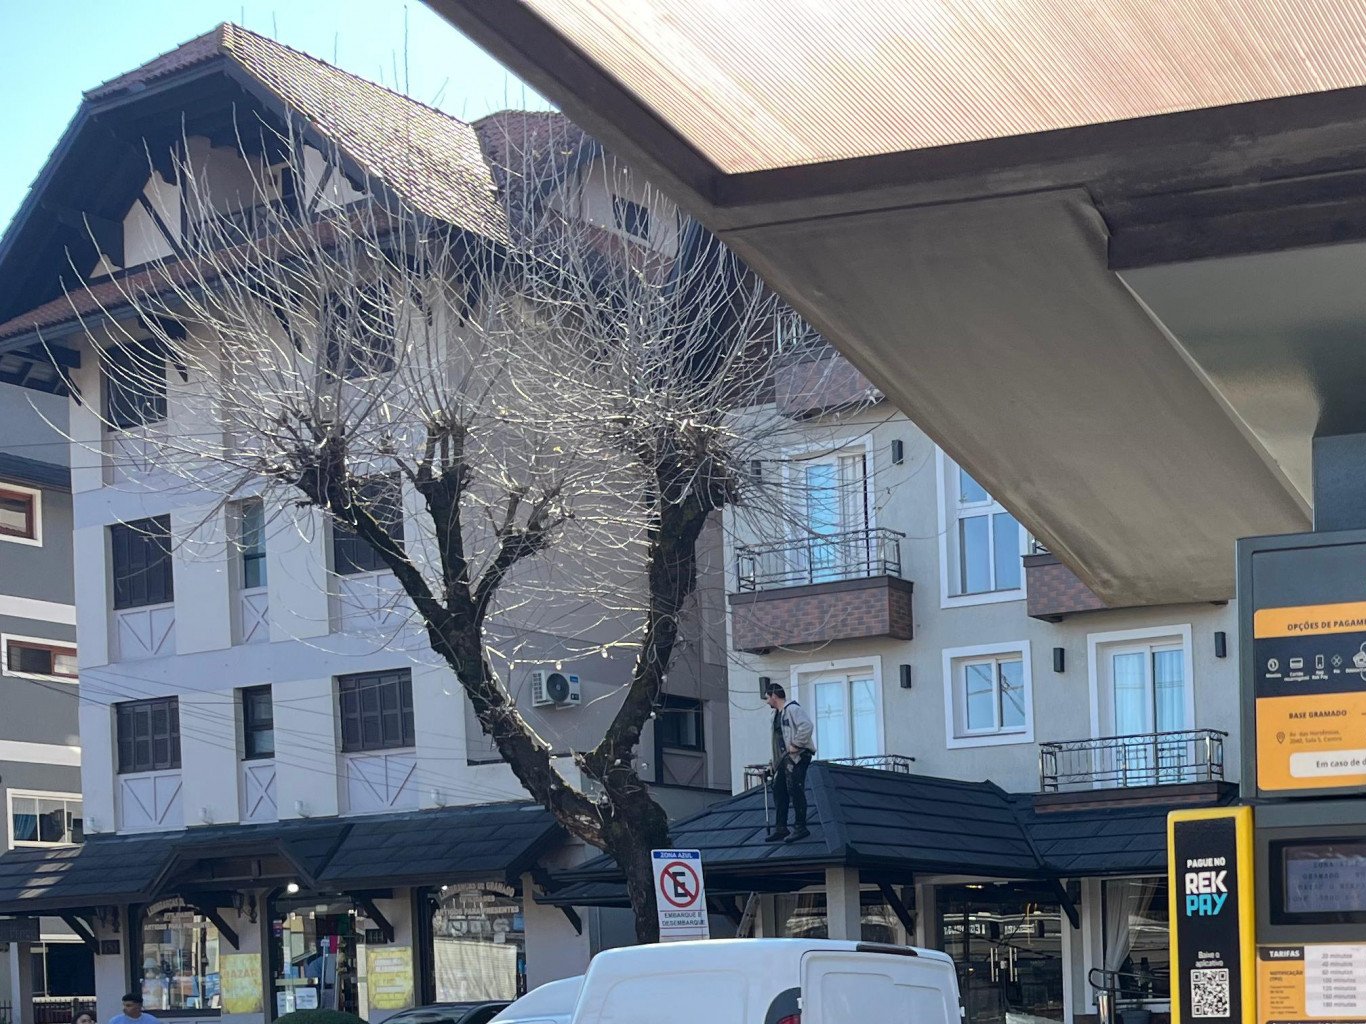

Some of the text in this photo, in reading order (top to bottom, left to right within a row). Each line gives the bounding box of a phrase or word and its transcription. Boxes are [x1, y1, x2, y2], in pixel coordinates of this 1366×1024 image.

[1287, 621, 1319, 631] OPÇÕES
[1309, 710, 1347, 718] GRAMADO
[1316, 760, 1328, 768] Em
[1187, 857, 1226, 868] PAGUE NO
[672, 872, 688, 897] E
[1185, 870, 1228, 894] REK
[1186, 893, 1228, 916] PAY
